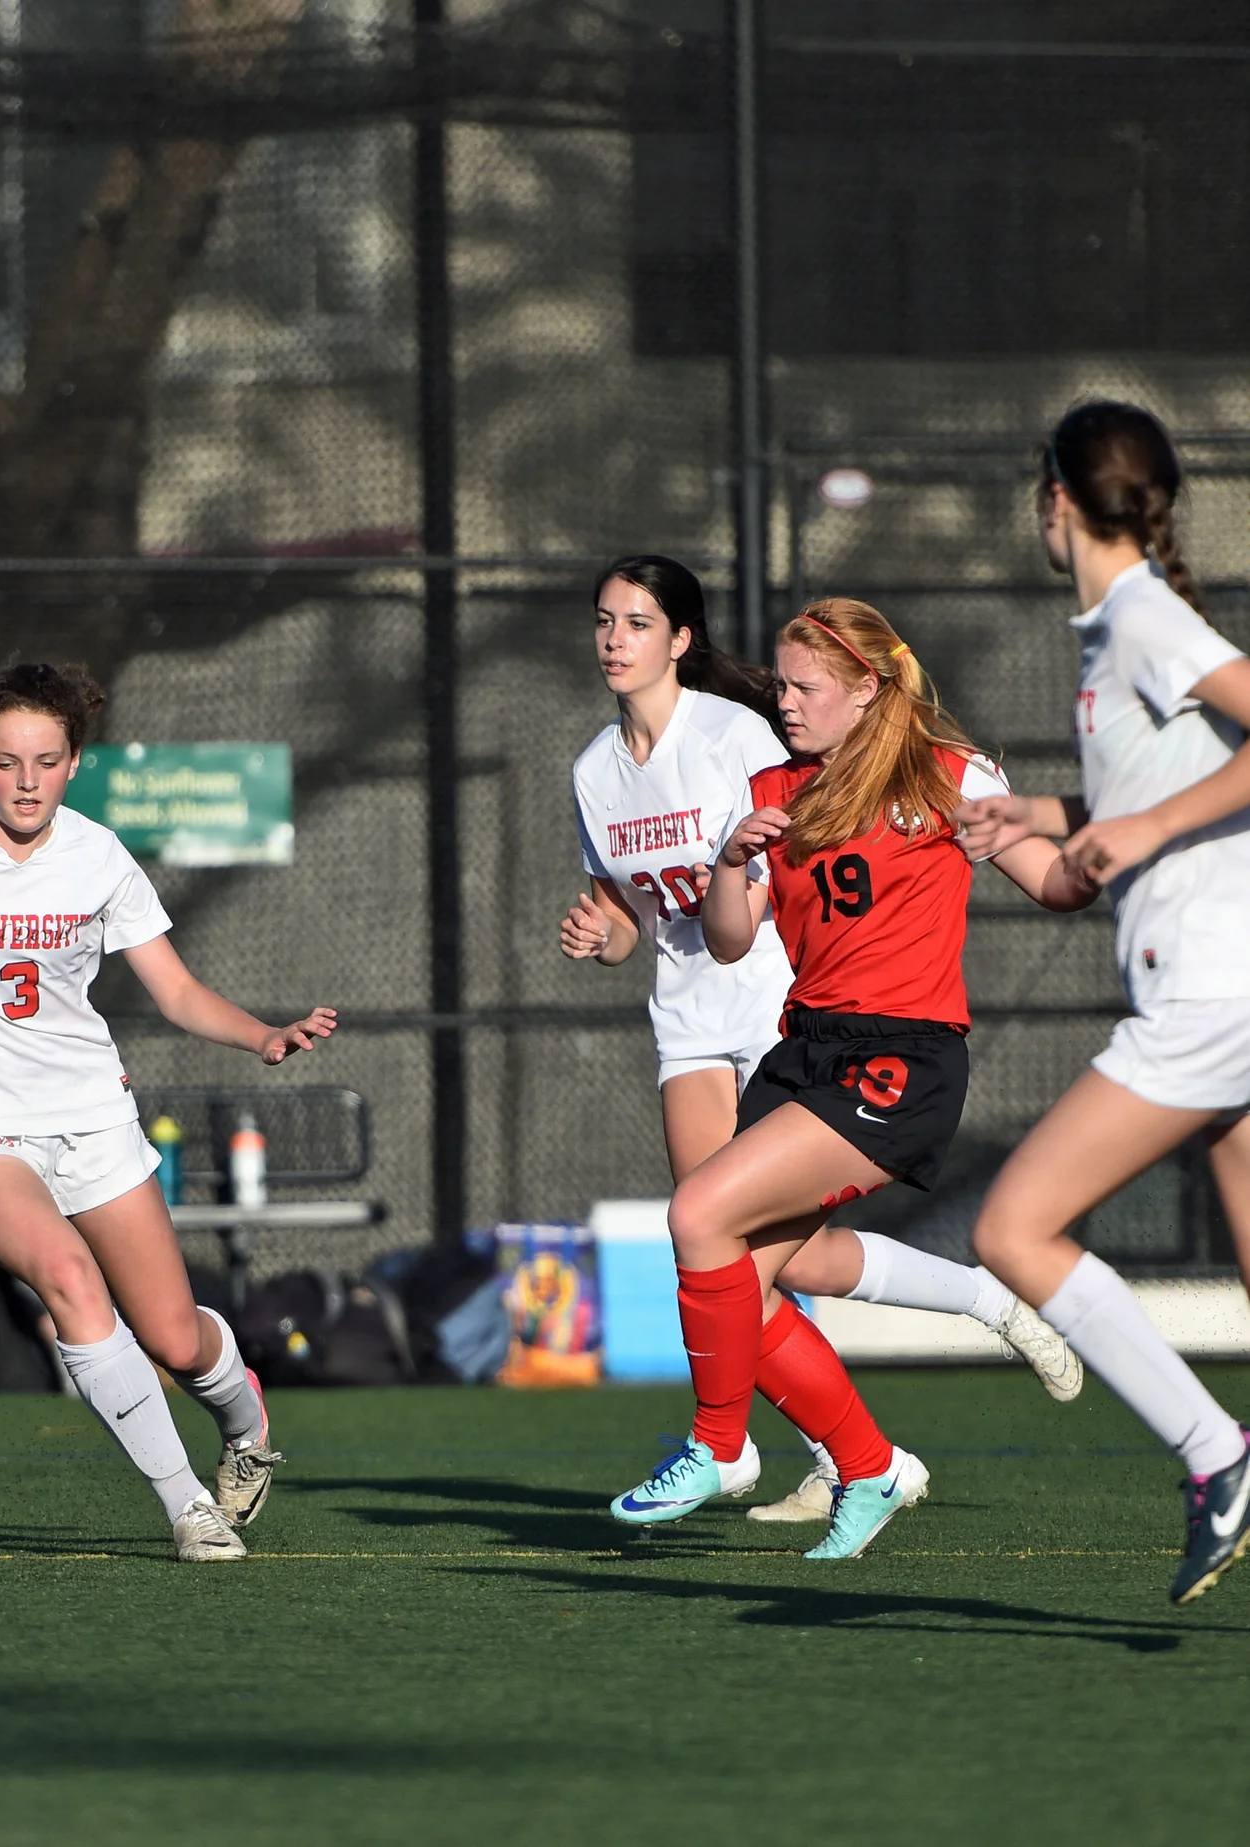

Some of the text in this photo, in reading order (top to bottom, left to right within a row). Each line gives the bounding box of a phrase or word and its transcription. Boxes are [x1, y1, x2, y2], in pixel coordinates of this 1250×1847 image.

[607, 807, 704, 858] UNIVERSITY
[810, 853, 874, 924] 19
[0, 961, 40, 1021] 3
